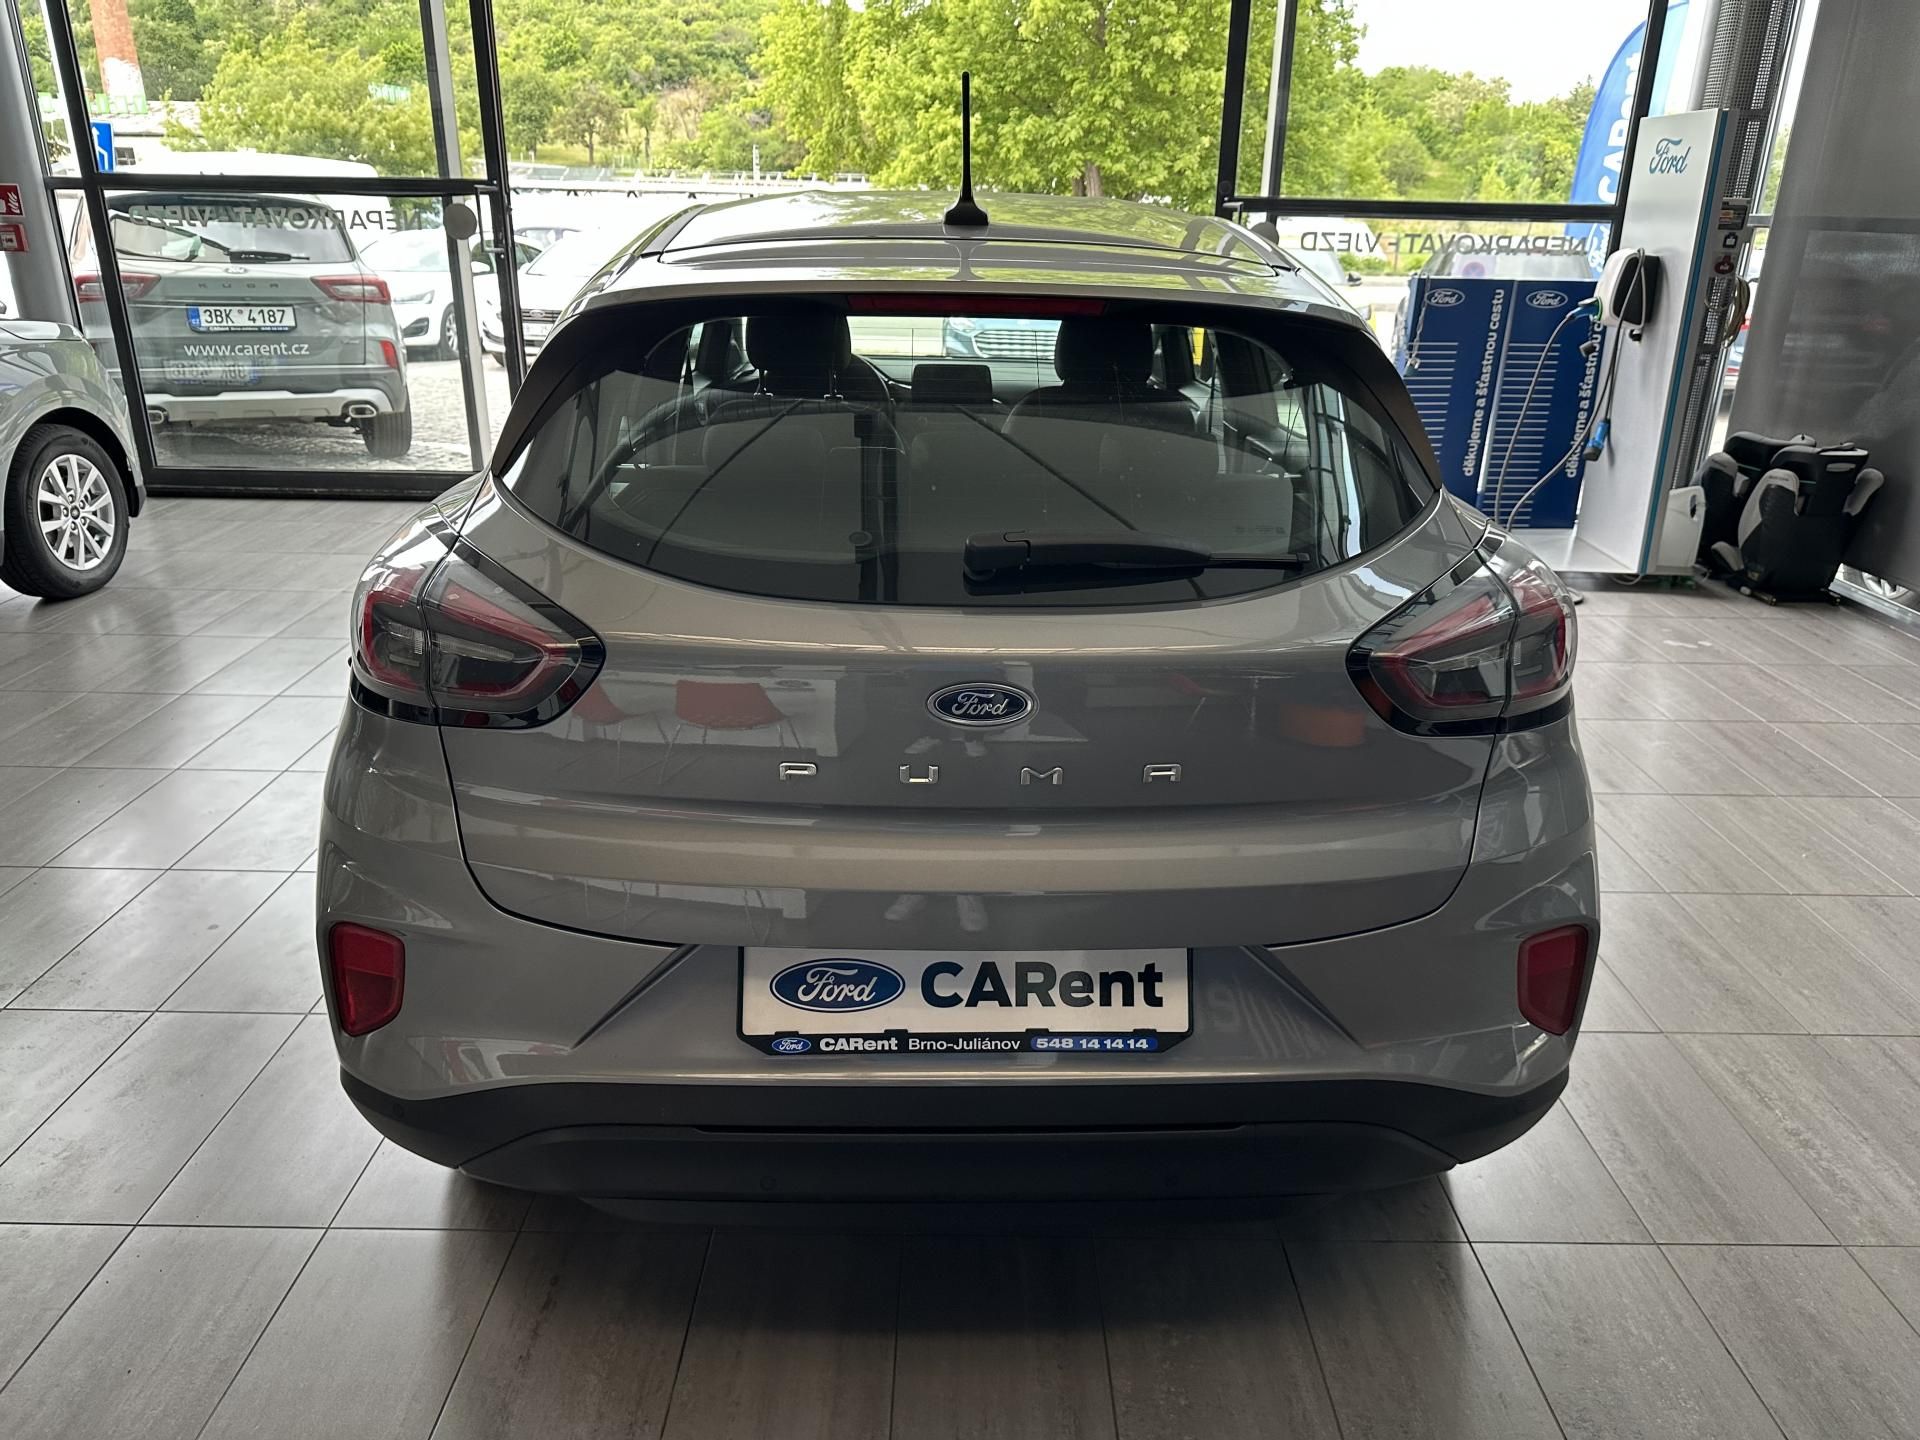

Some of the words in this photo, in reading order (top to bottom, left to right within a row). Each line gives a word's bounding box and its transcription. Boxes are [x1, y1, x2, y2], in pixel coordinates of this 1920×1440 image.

[1648, 137, 1691, 175] Ford
[1430, 290, 1458, 304] Ford
[1533, 291, 1561, 306] Ford
[203, 308, 235, 324] 3BK
[247, 308, 286, 324] 4187
[1488, 289, 1505, 330] cestu
[183, 341, 310, 356] www.carent.cz
[1475, 332, 1496, 396] šťastnou
[1476, 397, 1486, 407] a
[1579, 400, 1589, 411] a
[1463, 409, 1484, 476] děkujeme
[951, 691, 1008, 716] Ford
[779, 762, 1182, 785] PUMA
[797, 966, 877, 1003] Ford
[920, 960, 1164, 1008] CARent
[776, 1038, 804, 1051] Ford
[819, 1037, 898, 1051] CARent
[908, 1037, 1020, 1051] Brno-Juliánov
[1036, 1038, 1074, 1050] 548
[1080, 1039, 1100, 1050] 14
[1104, 1039, 1124, 1050] 14
[1127, 1039, 1148, 1050] 14
